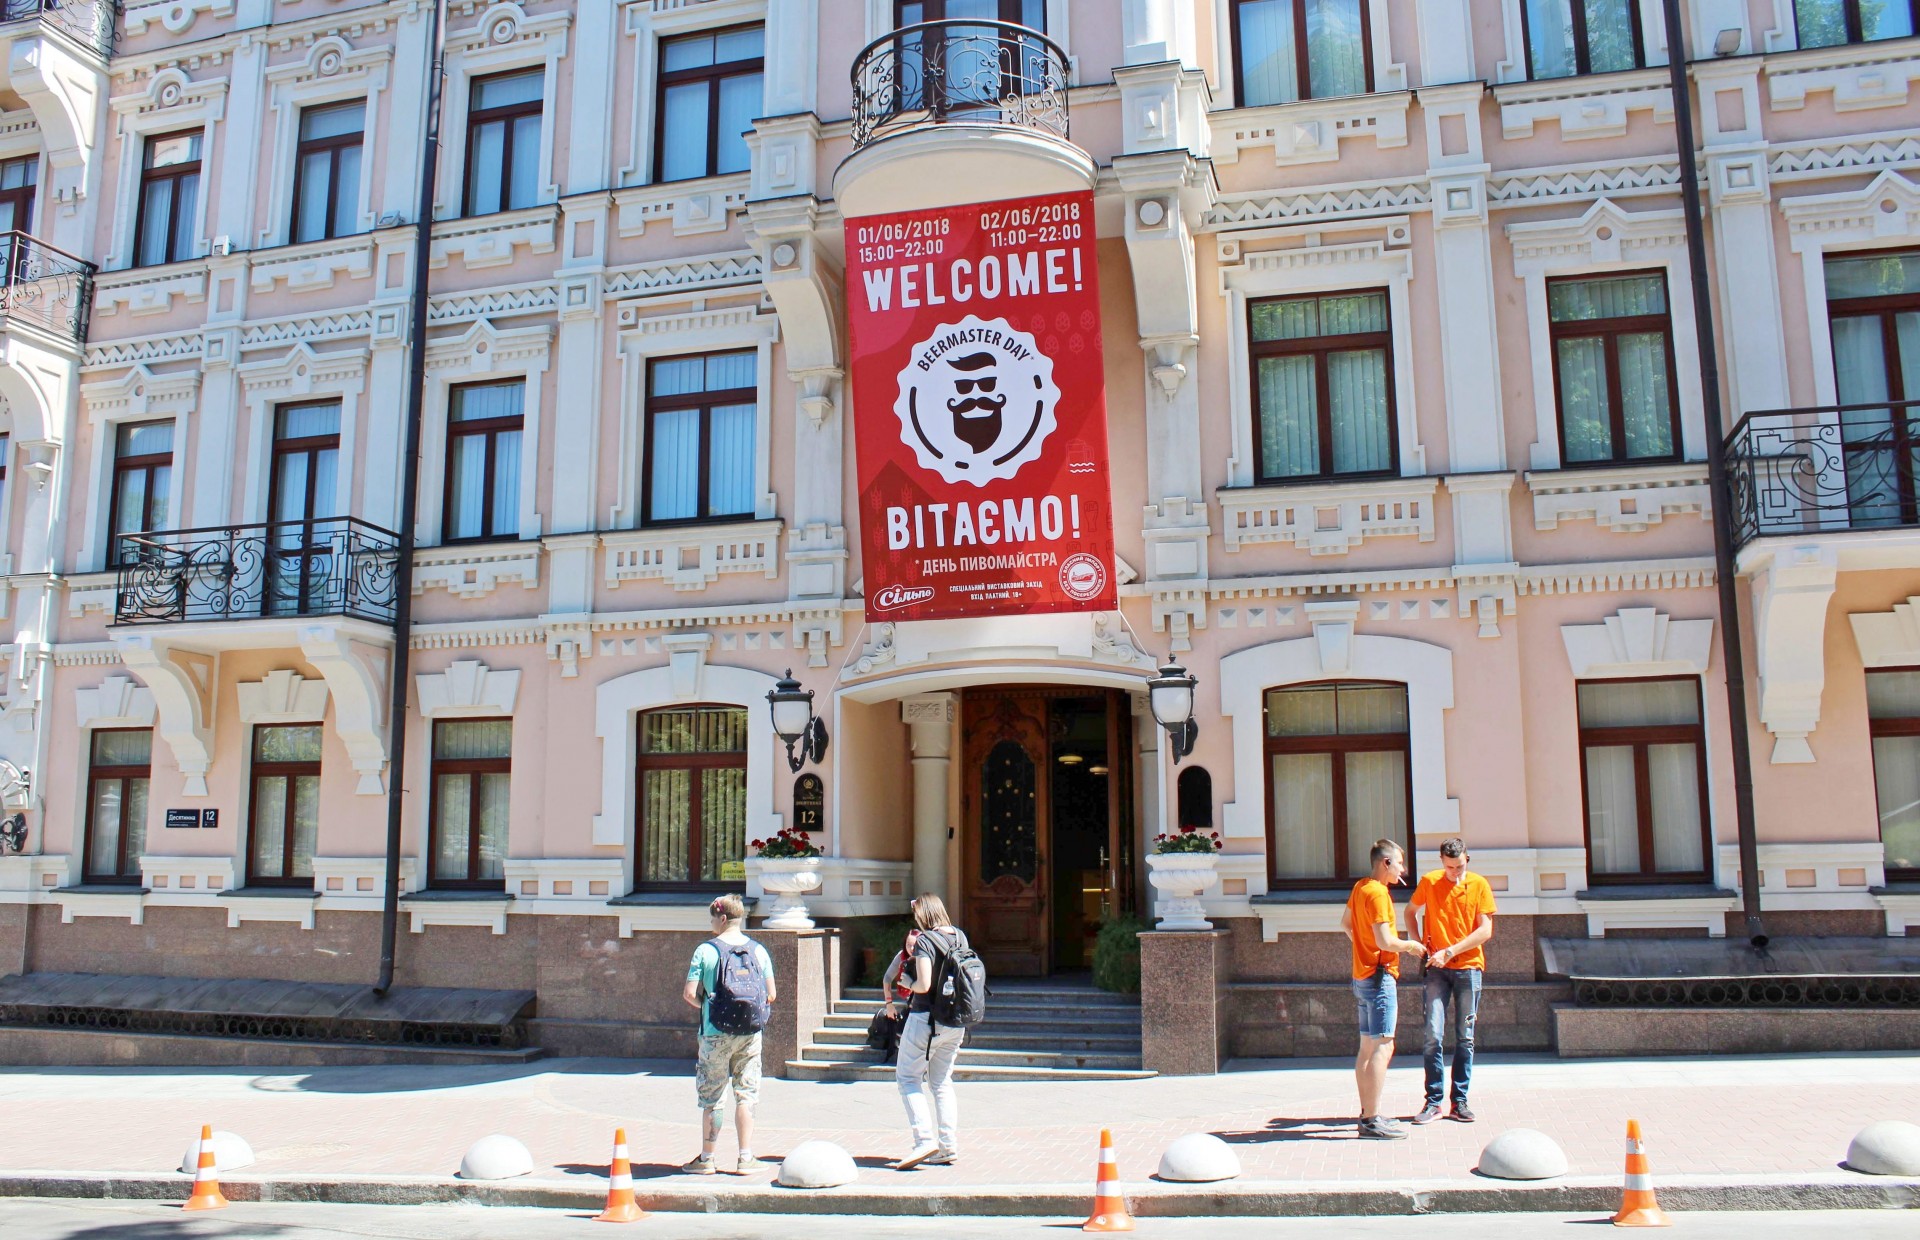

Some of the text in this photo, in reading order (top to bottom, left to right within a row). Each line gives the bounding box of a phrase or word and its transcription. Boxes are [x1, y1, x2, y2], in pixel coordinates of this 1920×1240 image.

[980, 202, 1080, 231] 02/06/2018
[858, 218, 950, 244] 01/06/2018
[862, 247, 1083, 313] WELCOME!
[917, 328, 1003, 372] BEERMASTER
[886, 494, 1081, 551] ВІТАЄМО!
[960, 551, 1058, 572] ПИВОМАЙСТРА
[880, 588, 932, 606] Сільпо
[949, 583, 986, 592] СПЕЦІАЛЬНИЙ
[987, 581, 1025, 590] ВИСТАВКОВИЙ
[205, 811, 215, 820] 12
[801, 811, 816, 823] 12
